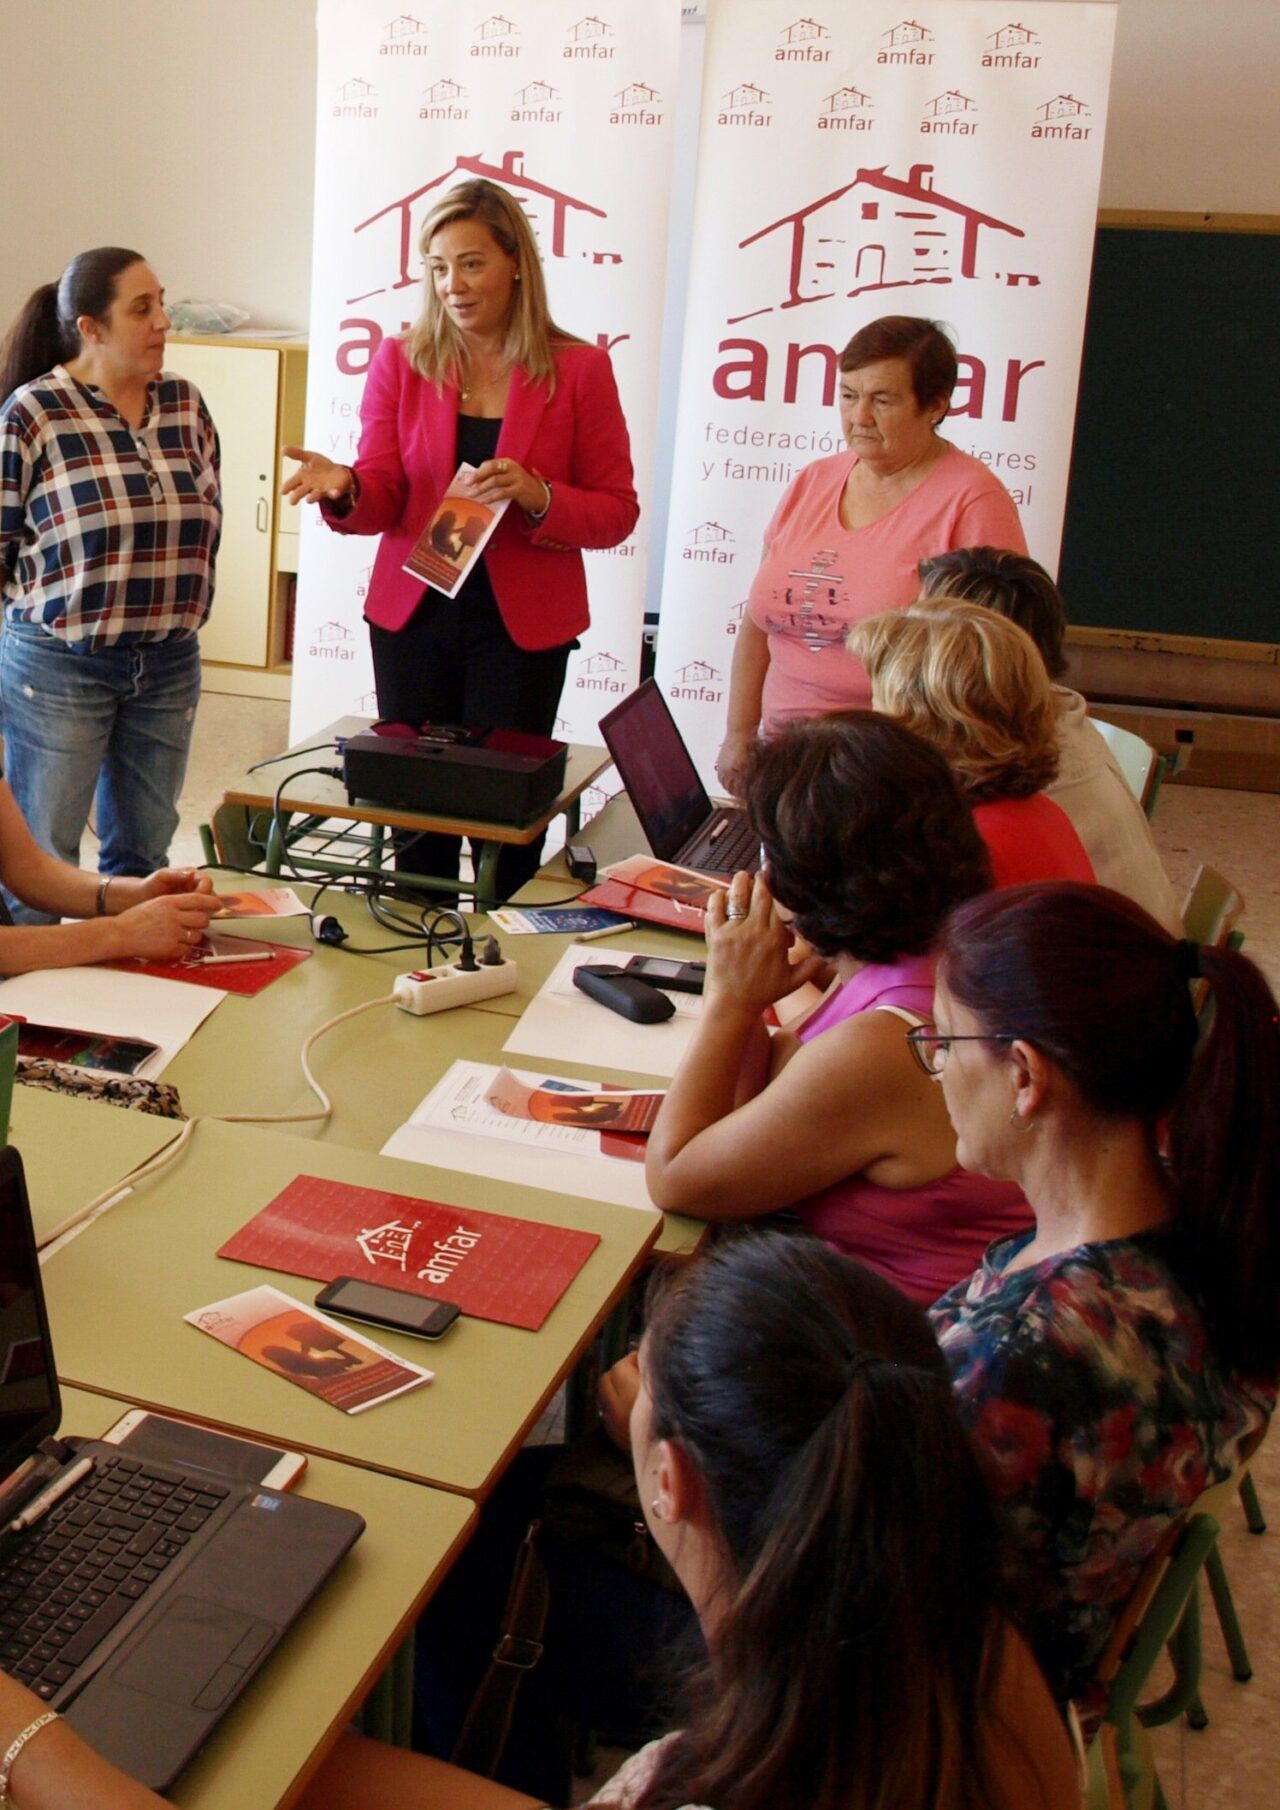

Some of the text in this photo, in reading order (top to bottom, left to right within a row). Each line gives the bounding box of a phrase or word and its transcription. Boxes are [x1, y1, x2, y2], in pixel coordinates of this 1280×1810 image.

[379, 41, 430, 57] amfar
[470, 42, 520, 58] amfar
[563, 43, 615, 59] amfar
[775, 46, 832, 63] amfar
[877, 48, 935, 66] amfar
[981, 51, 1042, 69] amfar
[333, 104, 379, 119] amfar
[419, 105, 470, 121] amfar
[511, 107, 562, 123] amfar
[609, 109, 663, 126] amfar
[717, 111, 772, 128] amfar
[817, 113, 874, 131] amfar
[920, 117, 979, 136] amfar
[1031, 122, 1092, 141] amfar
[701, 458, 800, 483] y famili
[682, 547, 736, 564] amfar
[309, 645, 356, 661] amfar
[576, 677, 628, 693] amfar
[670, 686, 724, 703] amfar
[417, 1225, 483, 1285] amfar
